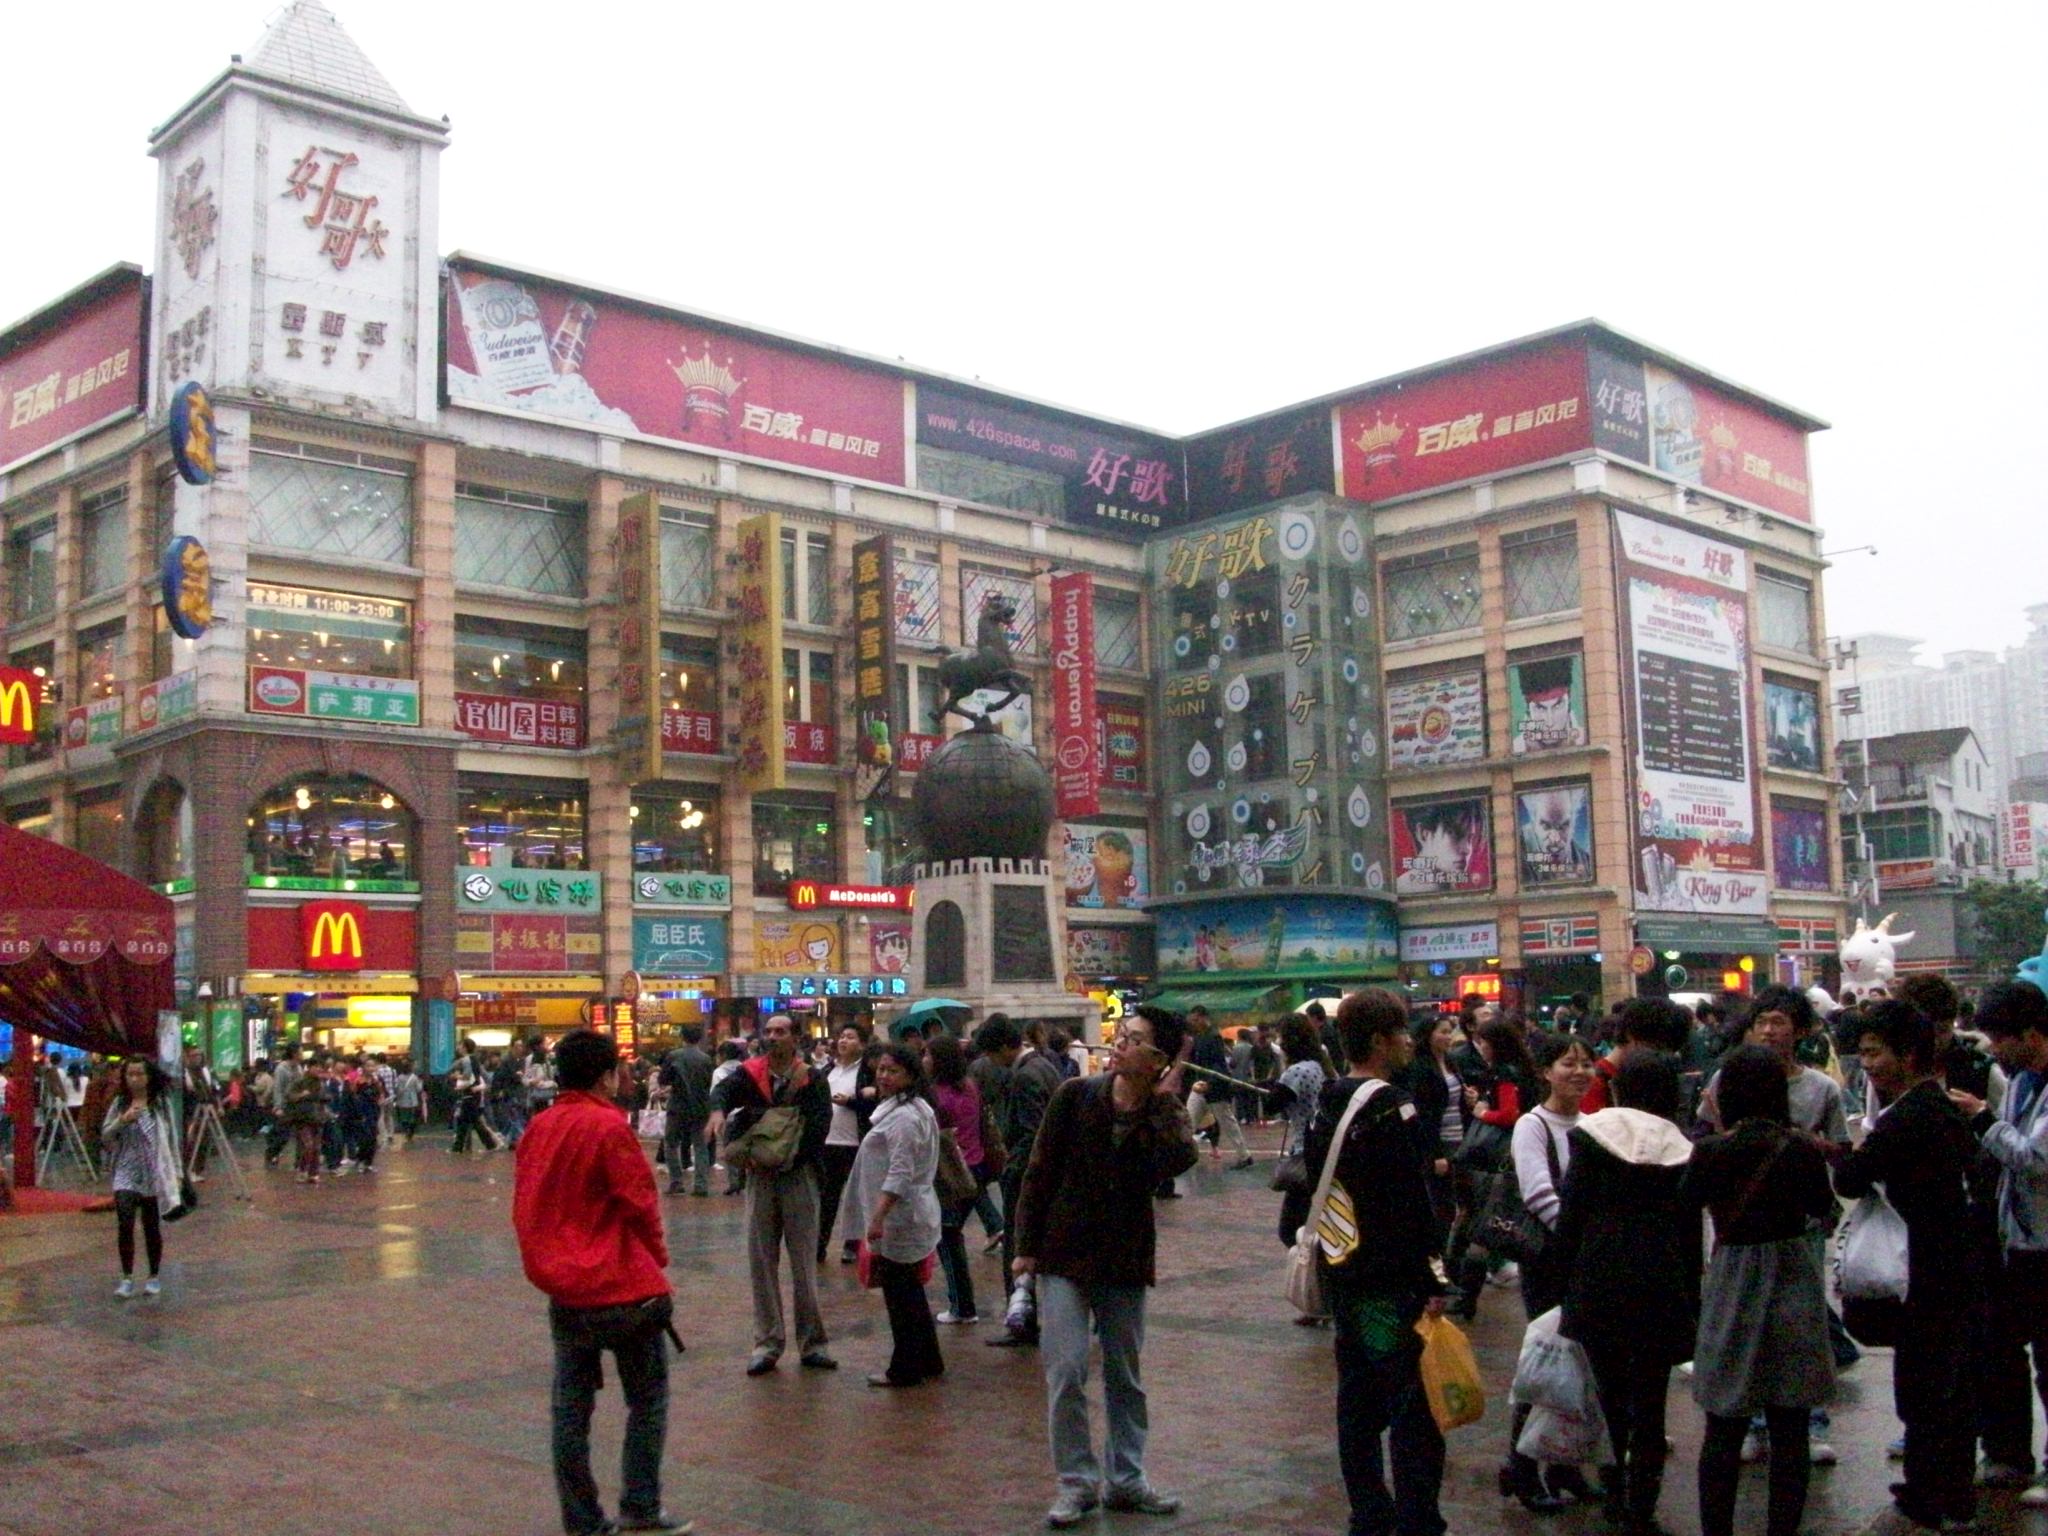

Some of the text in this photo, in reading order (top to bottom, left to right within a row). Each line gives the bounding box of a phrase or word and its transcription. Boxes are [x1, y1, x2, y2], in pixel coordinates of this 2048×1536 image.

[281, 145, 389, 270] 好歌
[9, 371, 61, 429] 百威
[1596, 378, 1645, 425] 好歌
[740, 403, 804, 441] 百威
[1415, 413, 1483, 457] 百威
[1082, 447, 1175, 505] 好歌
[1164, 517, 1274, 589] 好歌
[252, 588, 308, 610] 营业时间
[1230, 608, 1270, 627] KTV
[1166, 673, 1211, 697] 426
[317, 692, 408, 718] 萨莉亚
[541, 704, 577, 726] 日韩
[1166, 698, 1206, 718] MINI
[540, 726, 577, 746] 料理
[829, 889, 897, 903] McDonald's
[1685, 877, 1757, 904] King Bar
[651, 923, 706, 946] 屈臣氏
